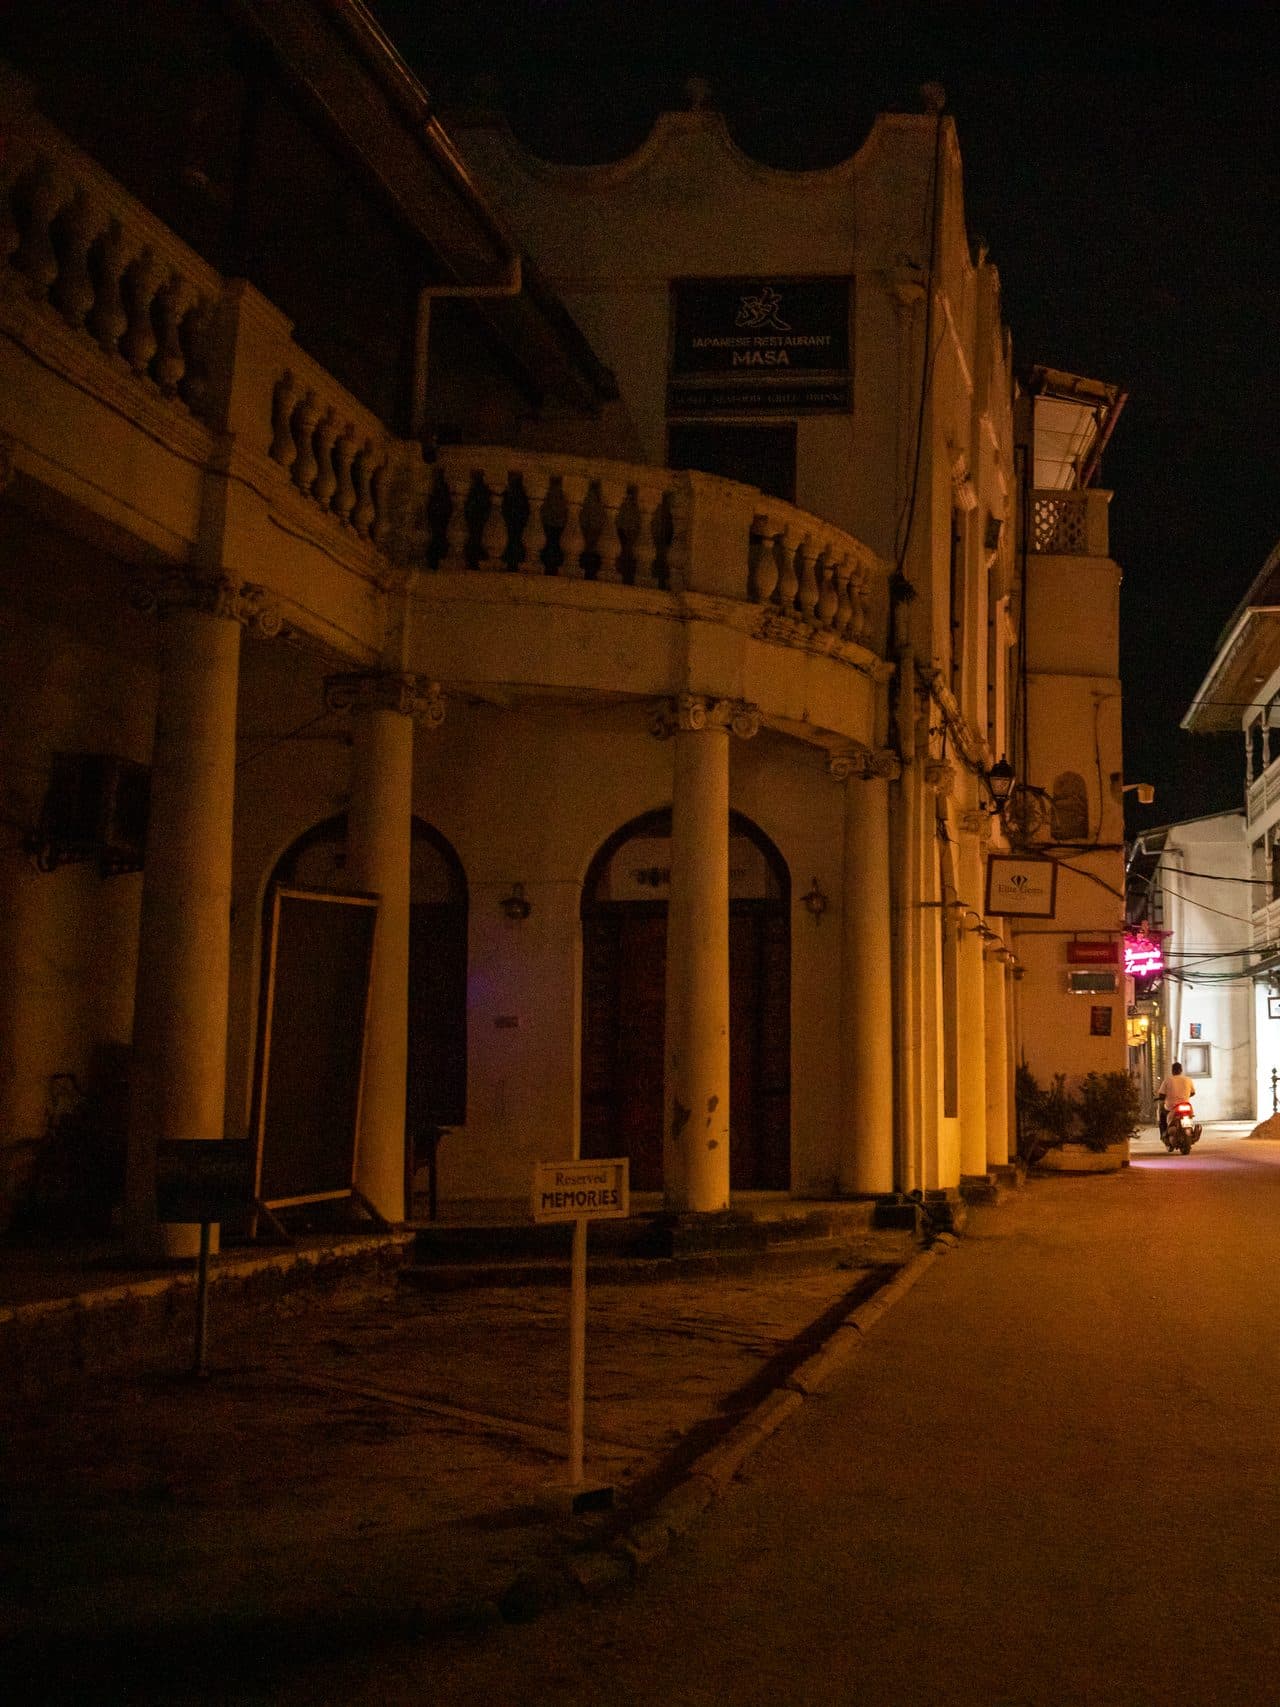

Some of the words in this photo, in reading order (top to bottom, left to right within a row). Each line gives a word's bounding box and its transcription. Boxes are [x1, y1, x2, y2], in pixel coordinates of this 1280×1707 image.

[692, 335, 751, 348] JAPANESE
[754, 335, 832, 347] RESTAURANT
[732, 350, 790, 367] MASA
[555, 1171, 608, 1186] Reserved
[541, 1189, 619, 1209] MEMORIES
